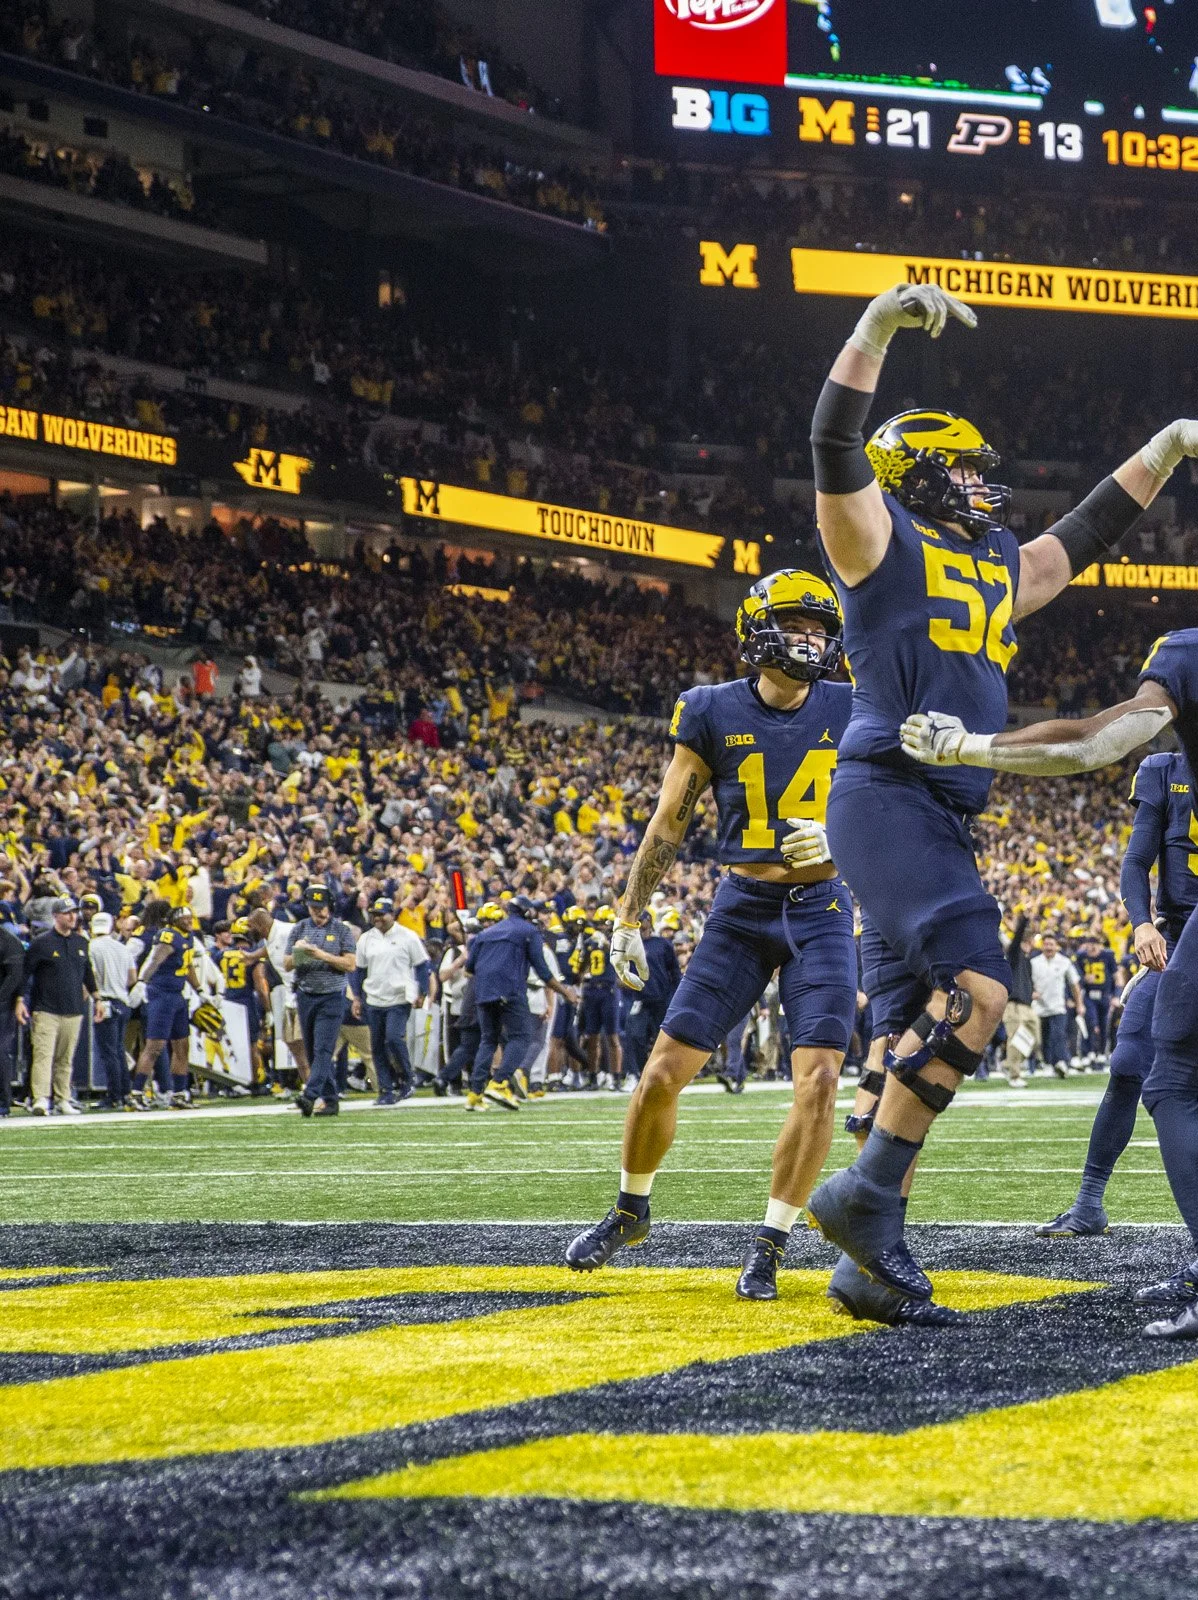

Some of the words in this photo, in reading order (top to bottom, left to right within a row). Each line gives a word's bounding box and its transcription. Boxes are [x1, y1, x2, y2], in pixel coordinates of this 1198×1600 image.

[798, 97, 855, 145] M
[886, 108, 931, 149] 21
[947, 112, 1012, 155] P
[1038, 121, 1083, 162] 13
[700, 241, 759, 288] M
[906, 263, 1054, 300] MICHIGAN
[42, 414, 177, 466] WOLVERINES
[536, 505, 656, 552] TOUCHDOWN
[733, 539, 762, 575] M
[921, 540, 1018, 674] 52
[737, 749, 839, 849] 14
